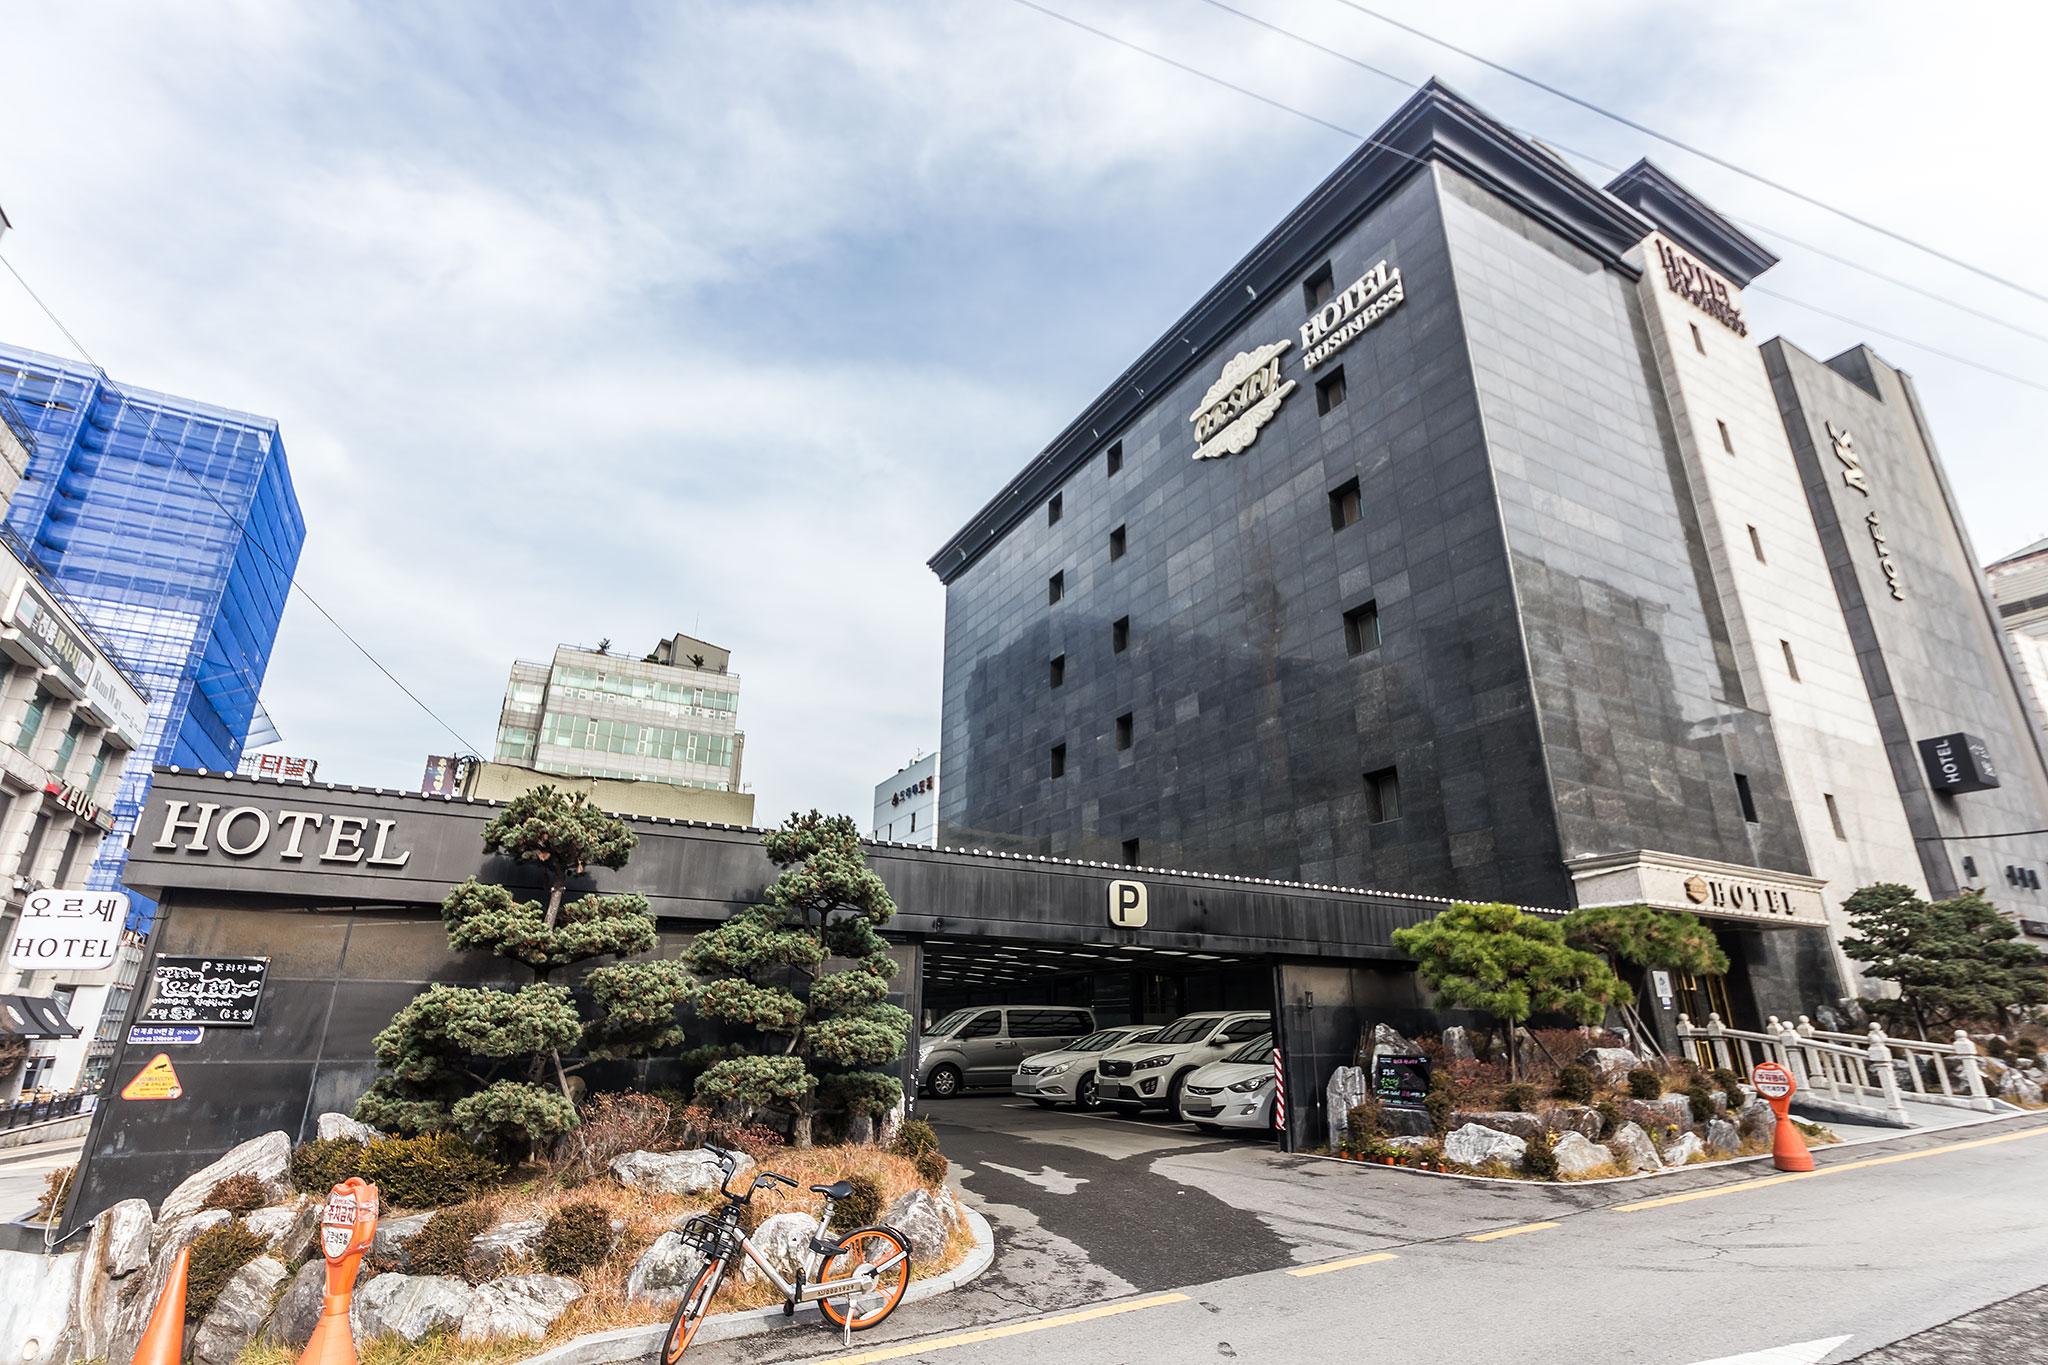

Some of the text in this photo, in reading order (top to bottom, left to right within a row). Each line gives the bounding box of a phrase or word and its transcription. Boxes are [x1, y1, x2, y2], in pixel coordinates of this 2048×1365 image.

[1299, 260, 1402, 350] HOTEL
[1302, 284, 1405, 371] BUSINESS
[1864, 510, 1907, 602] MOTEL
[1935, 738, 1961, 784] HOTEL
[56, 780, 97, 822] ZEUS
[152, 800, 411, 866] HOTEL
[23, 897, 118, 922] 오르세
[1118, 883, 1140, 922] P
[1709, 882, 1797, 916] HOTEL
[12, 938, 113, 958] HOTEL
[201, 961, 212, 972] P
